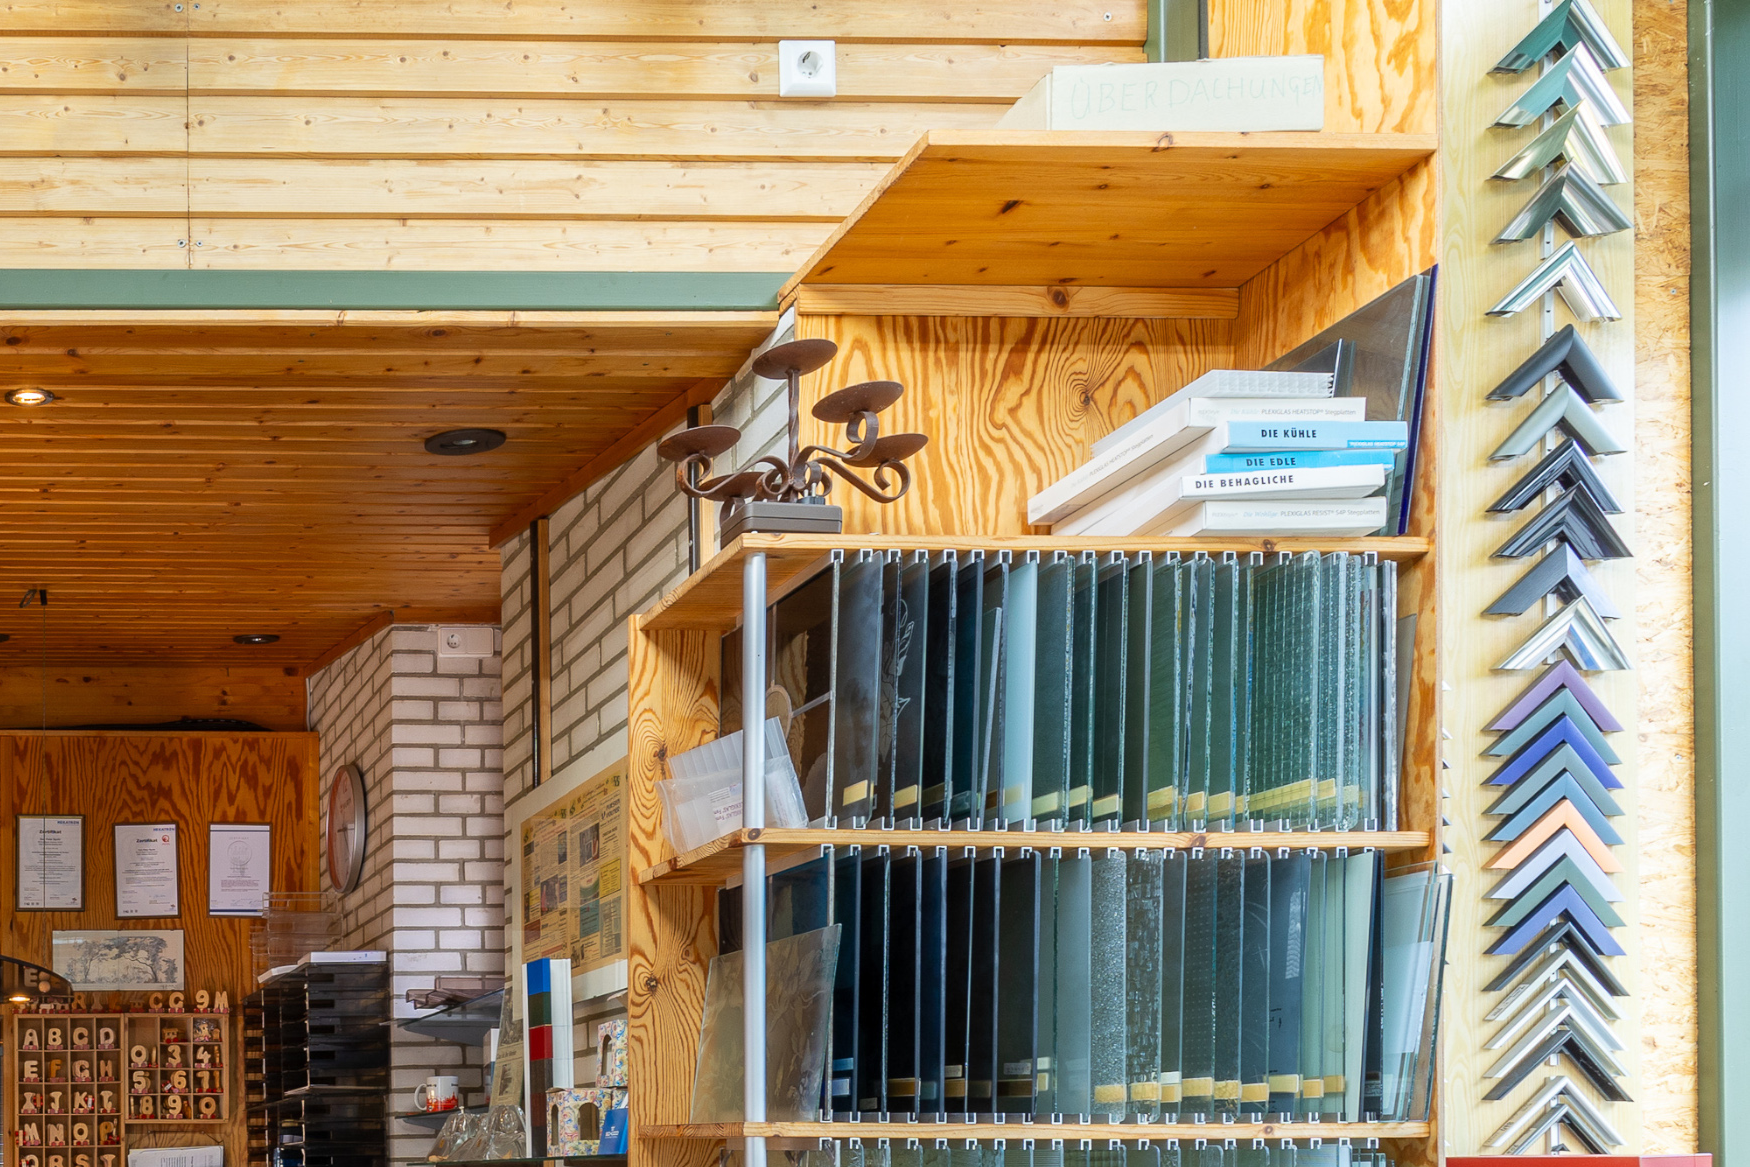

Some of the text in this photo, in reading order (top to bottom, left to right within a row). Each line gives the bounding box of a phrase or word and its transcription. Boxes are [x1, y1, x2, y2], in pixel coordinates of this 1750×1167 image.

[1261, 427, 1317, 438] DIE KÜHLE
[1246, 457, 1296, 466] DIE EDLE
[1195, 475, 1294, 489] DIE BEHAGLICHE
